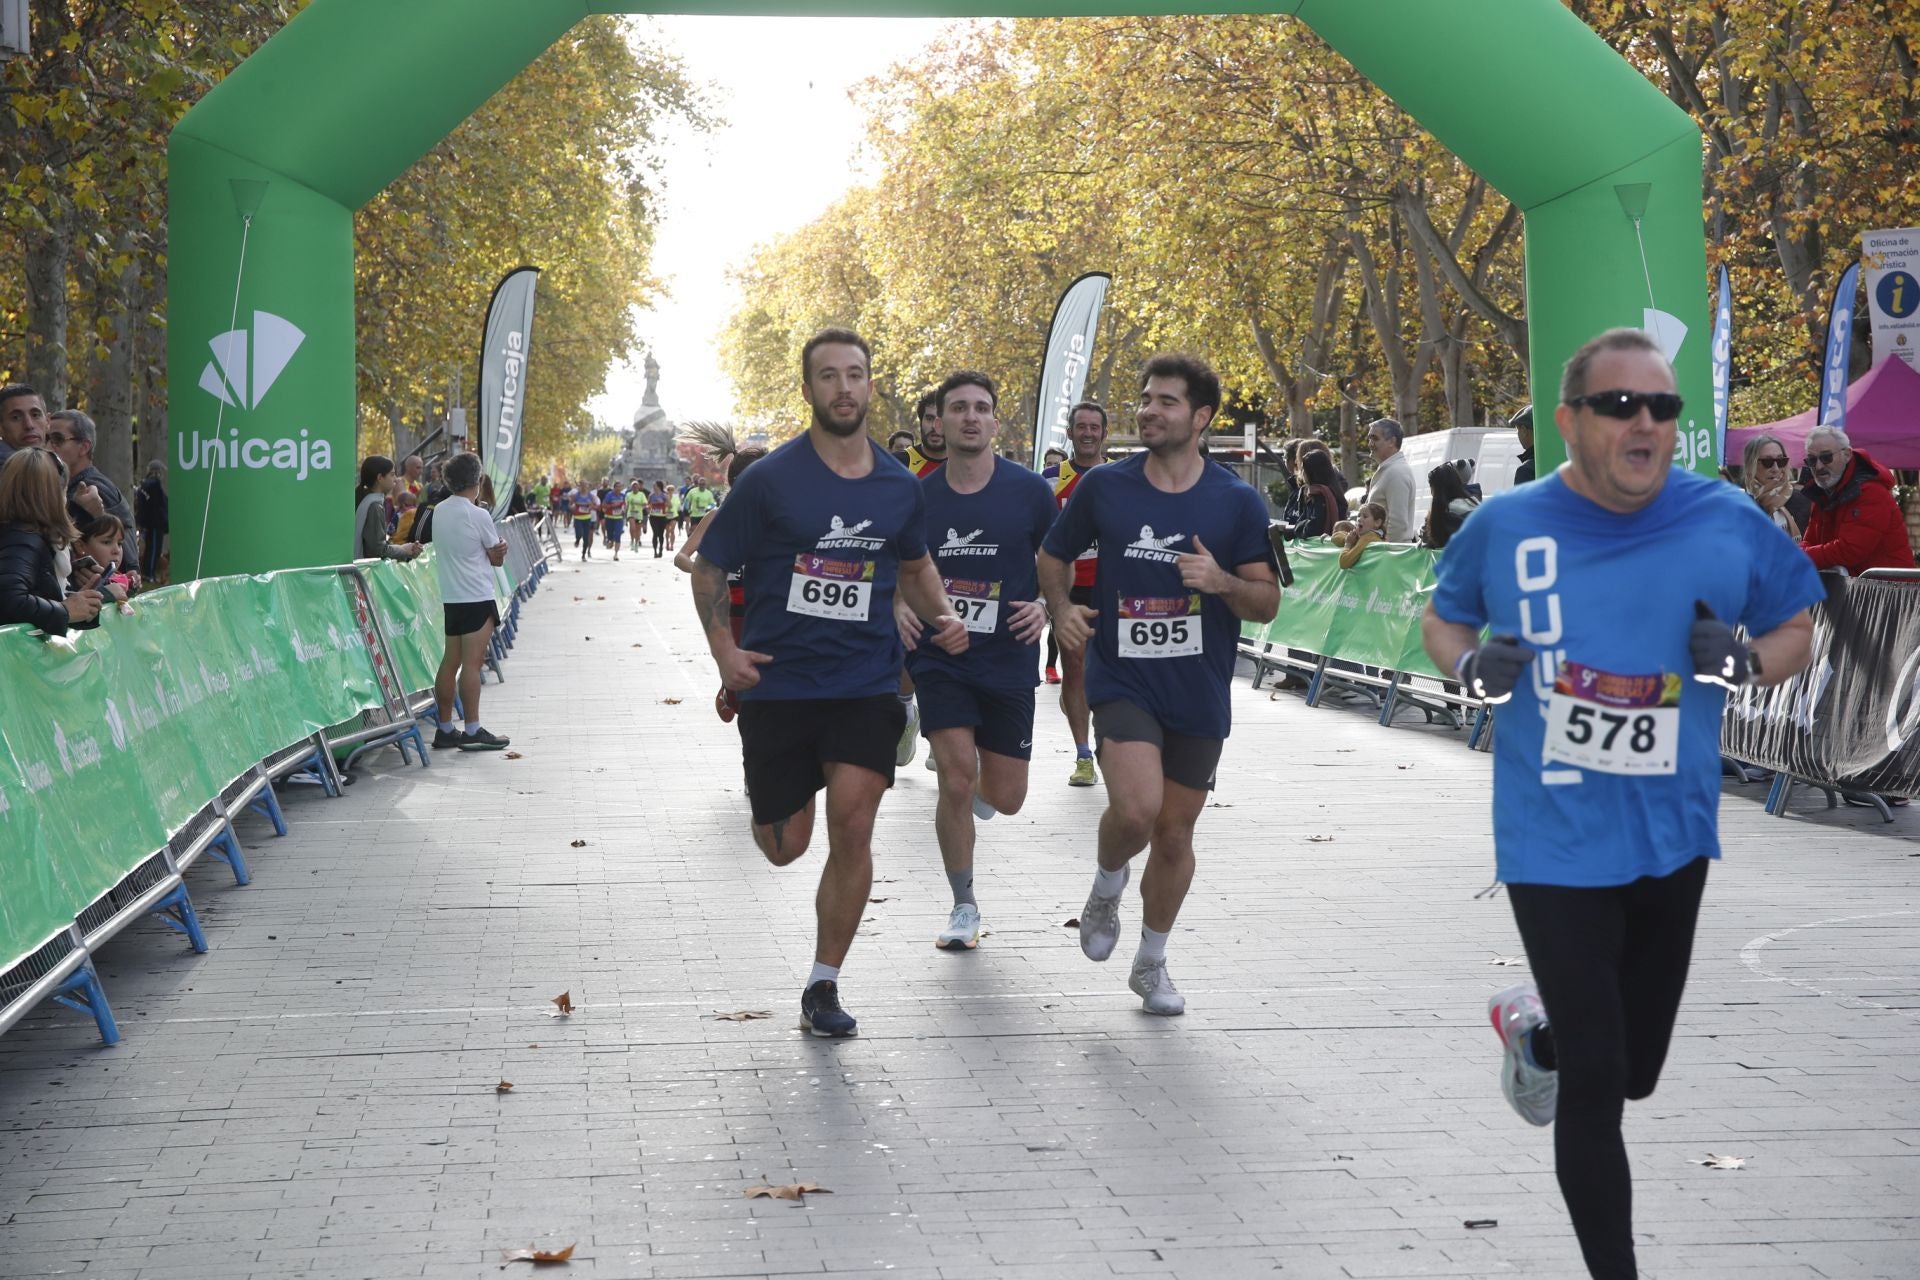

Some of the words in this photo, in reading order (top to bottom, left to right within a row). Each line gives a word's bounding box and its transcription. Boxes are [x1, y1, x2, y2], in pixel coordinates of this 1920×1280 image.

[1899, 237, 1909, 245] de
[1823, 308, 1850, 431] VECO
[496, 331, 525, 450] Unicaja
[1049, 334, 1085, 449] Unicaja
[178, 427, 332, 481] Unicaja
[1672, 419, 1711, 471] aja
[816, 539, 884, 551] MICHELIN
[938, 547, 998, 557] MICHELIN
[1124, 548, 1178, 563] MICHEL
[802, 579, 859, 608] 696
[949, 598, 987, 621] 97
[1130, 620, 1188, 645] 695
[1516, 536, 1583, 785] IECO
[1565, 704, 1656, 754] 578
